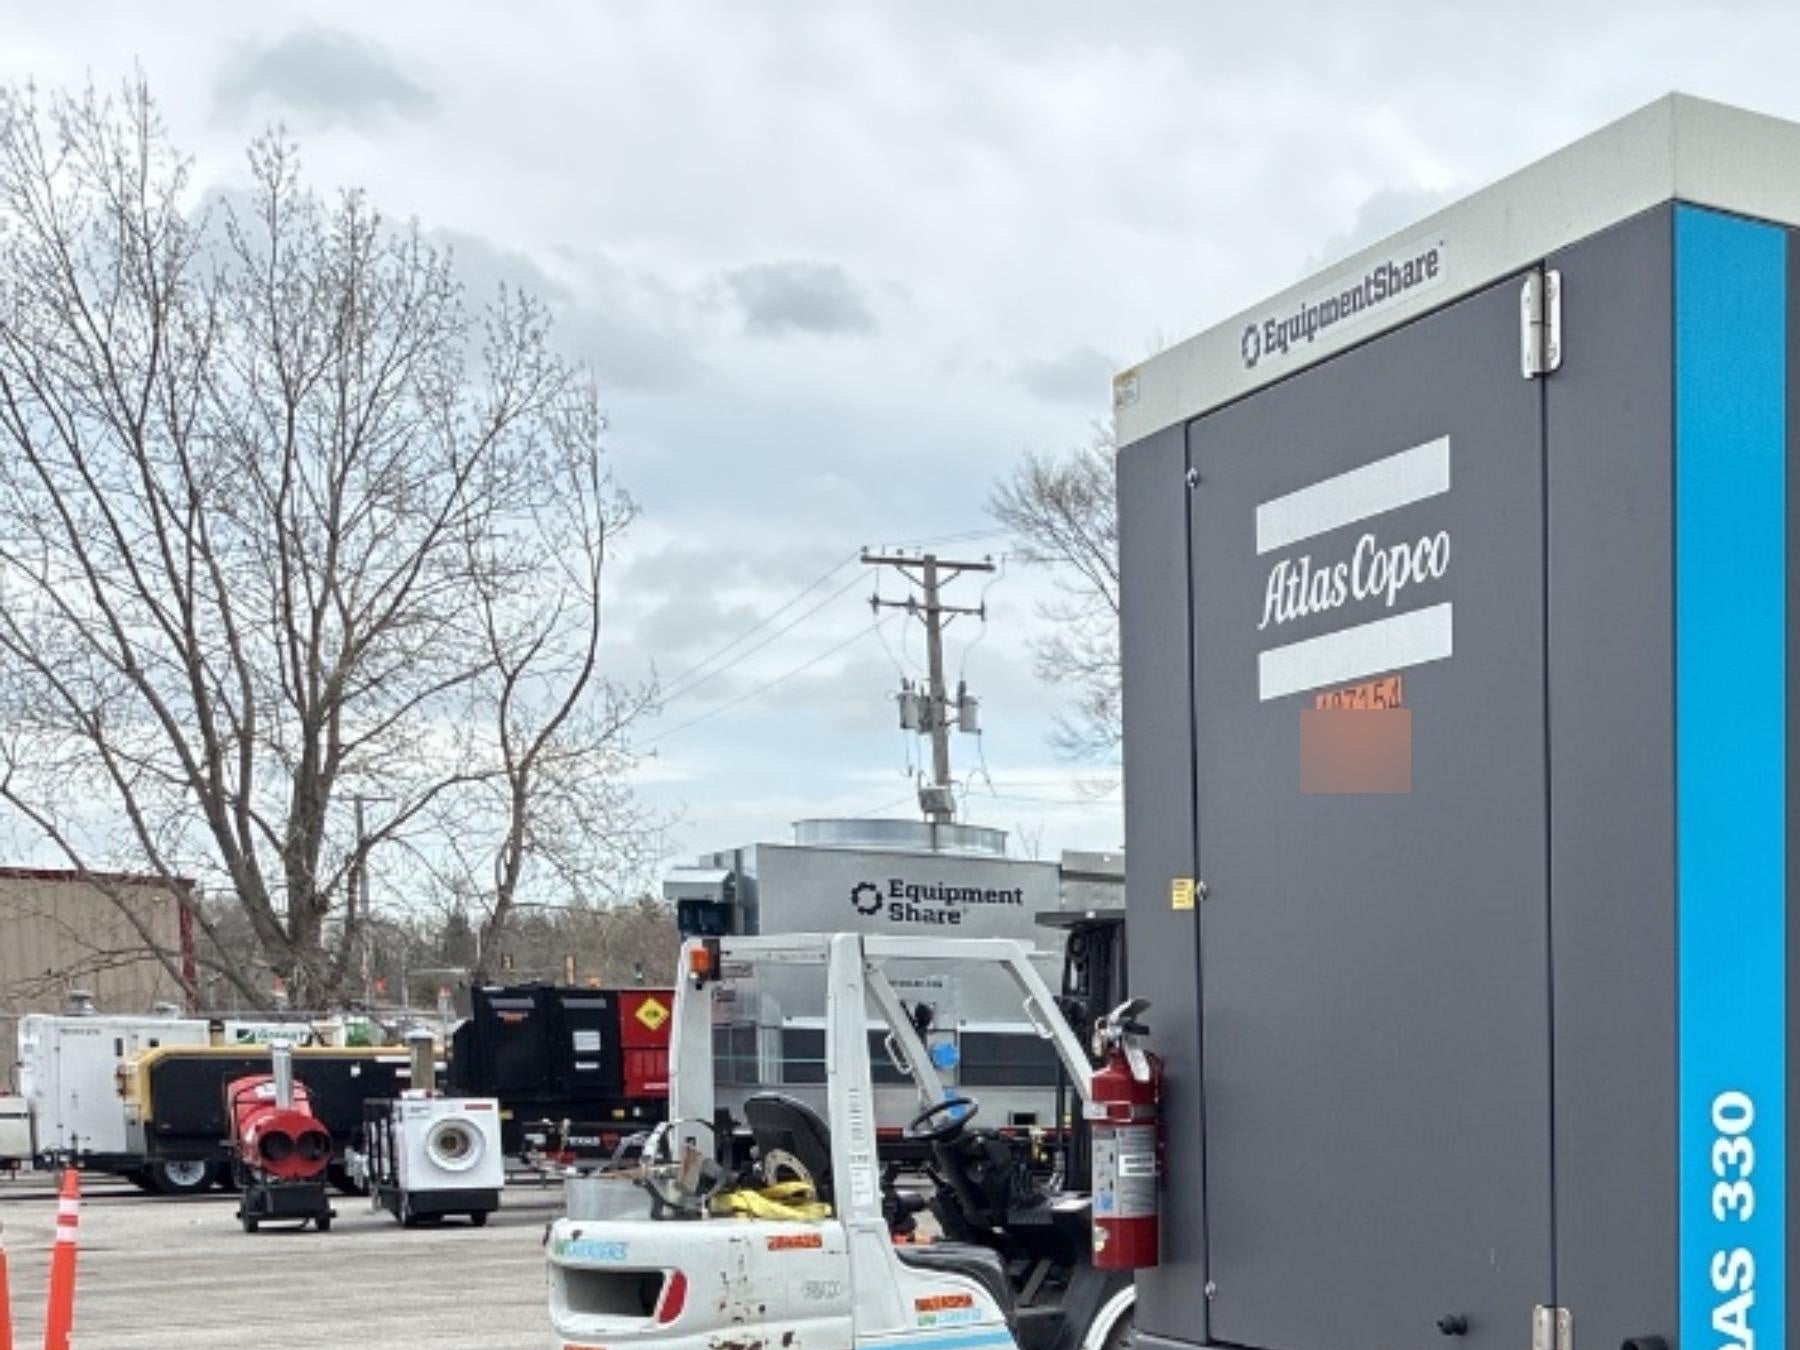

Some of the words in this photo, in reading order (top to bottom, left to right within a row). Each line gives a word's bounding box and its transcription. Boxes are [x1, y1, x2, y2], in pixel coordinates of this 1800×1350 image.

[1263, 248, 1439, 355] EquipmentShare
[1257, 555, 1348, 630] Atlas
[1352, 530, 1450, 607] Copco
[888, 878, 1024, 906] Equipment
[888, 902, 961, 925] Share
[1710, 1090, 1755, 1222] 330
